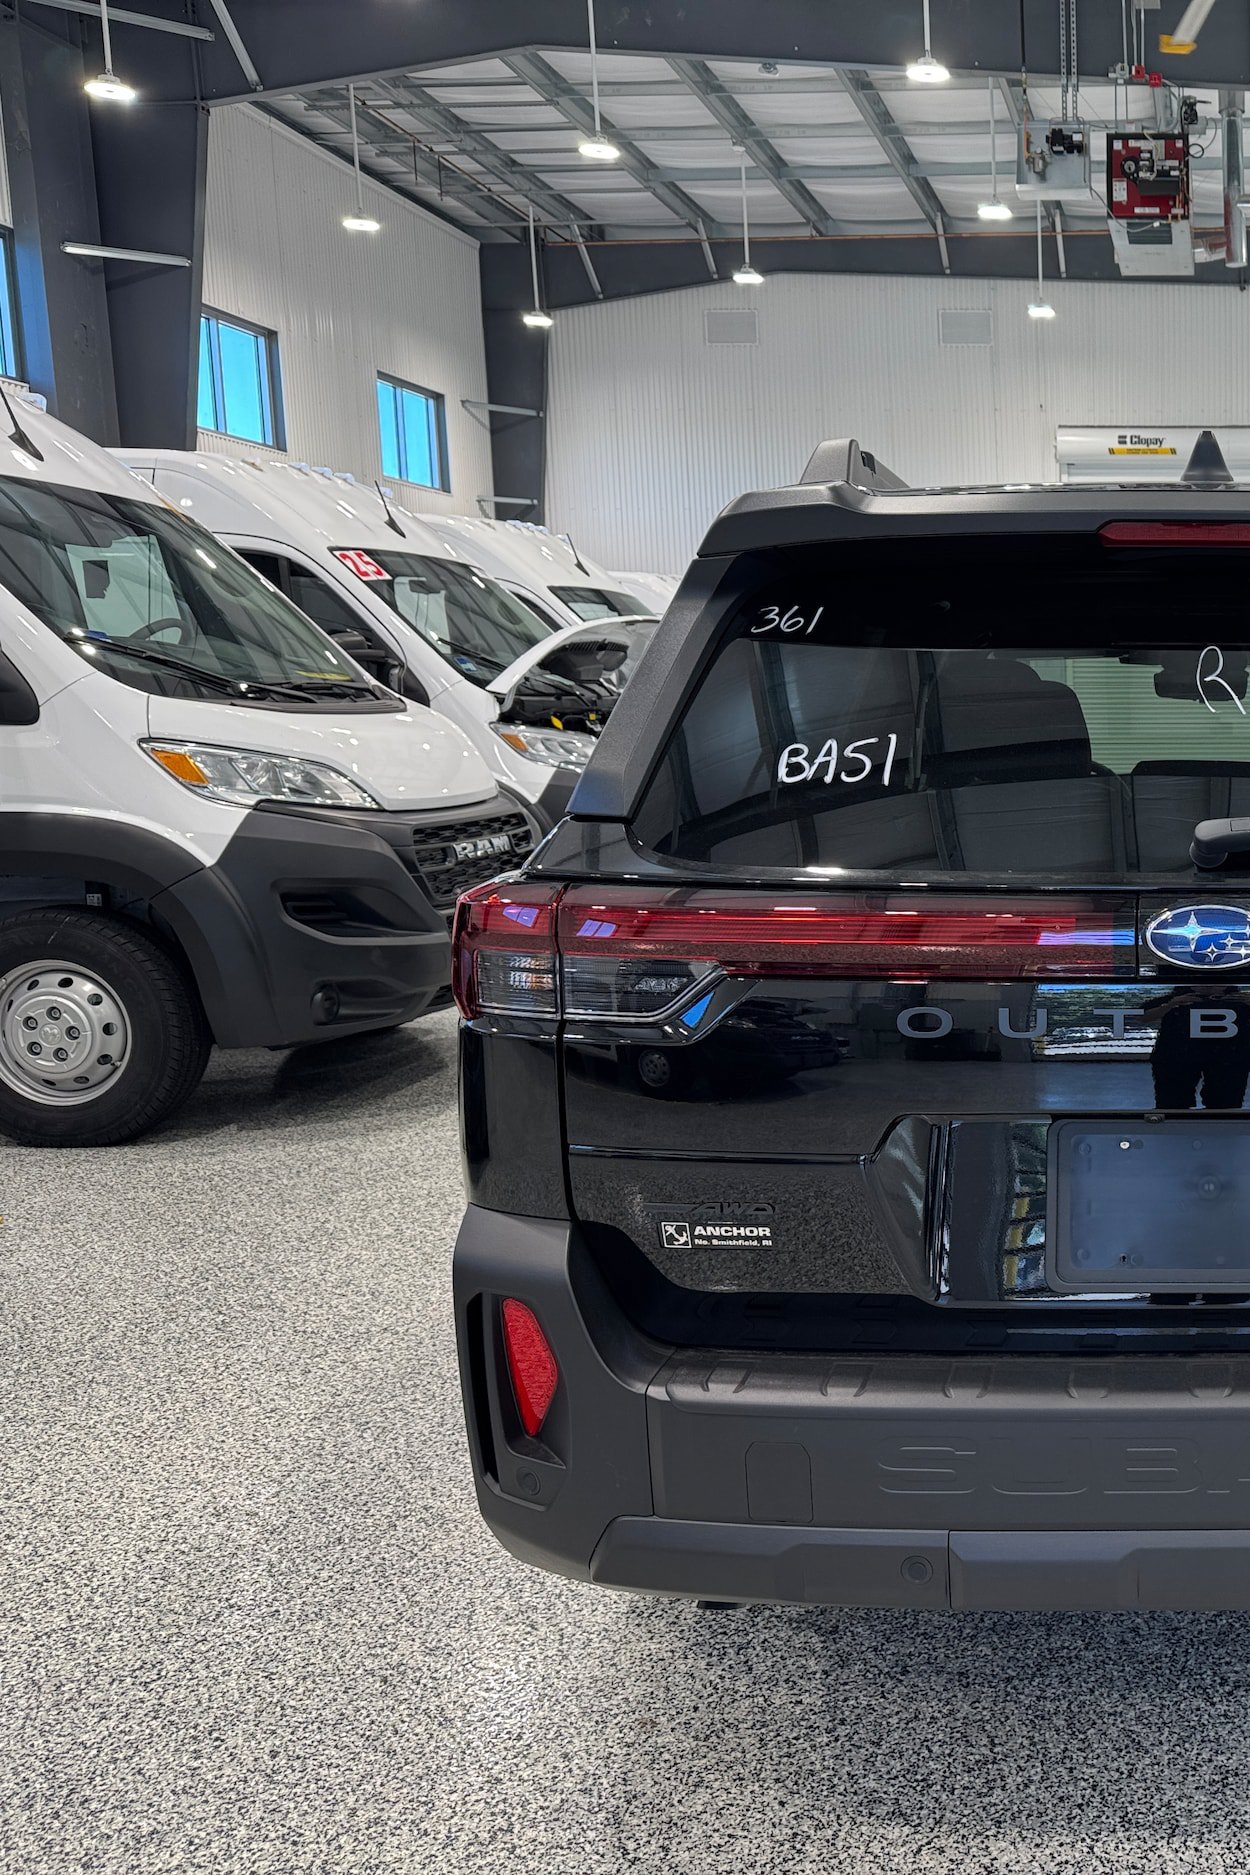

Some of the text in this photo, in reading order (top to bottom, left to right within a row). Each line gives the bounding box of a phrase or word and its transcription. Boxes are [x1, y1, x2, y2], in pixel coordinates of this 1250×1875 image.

[1130, 435, 1164, 448] Clopay
[339, 552, 384, 577] 25
[751, 605, 824, 635] 361
[452, 834, 511, 860] RAM
[690, 1202, 776, 1215] AWD
[694, 1226, 771, 1237] ANCHOR
[712, 1239, 760, 1247] Smithfield,
